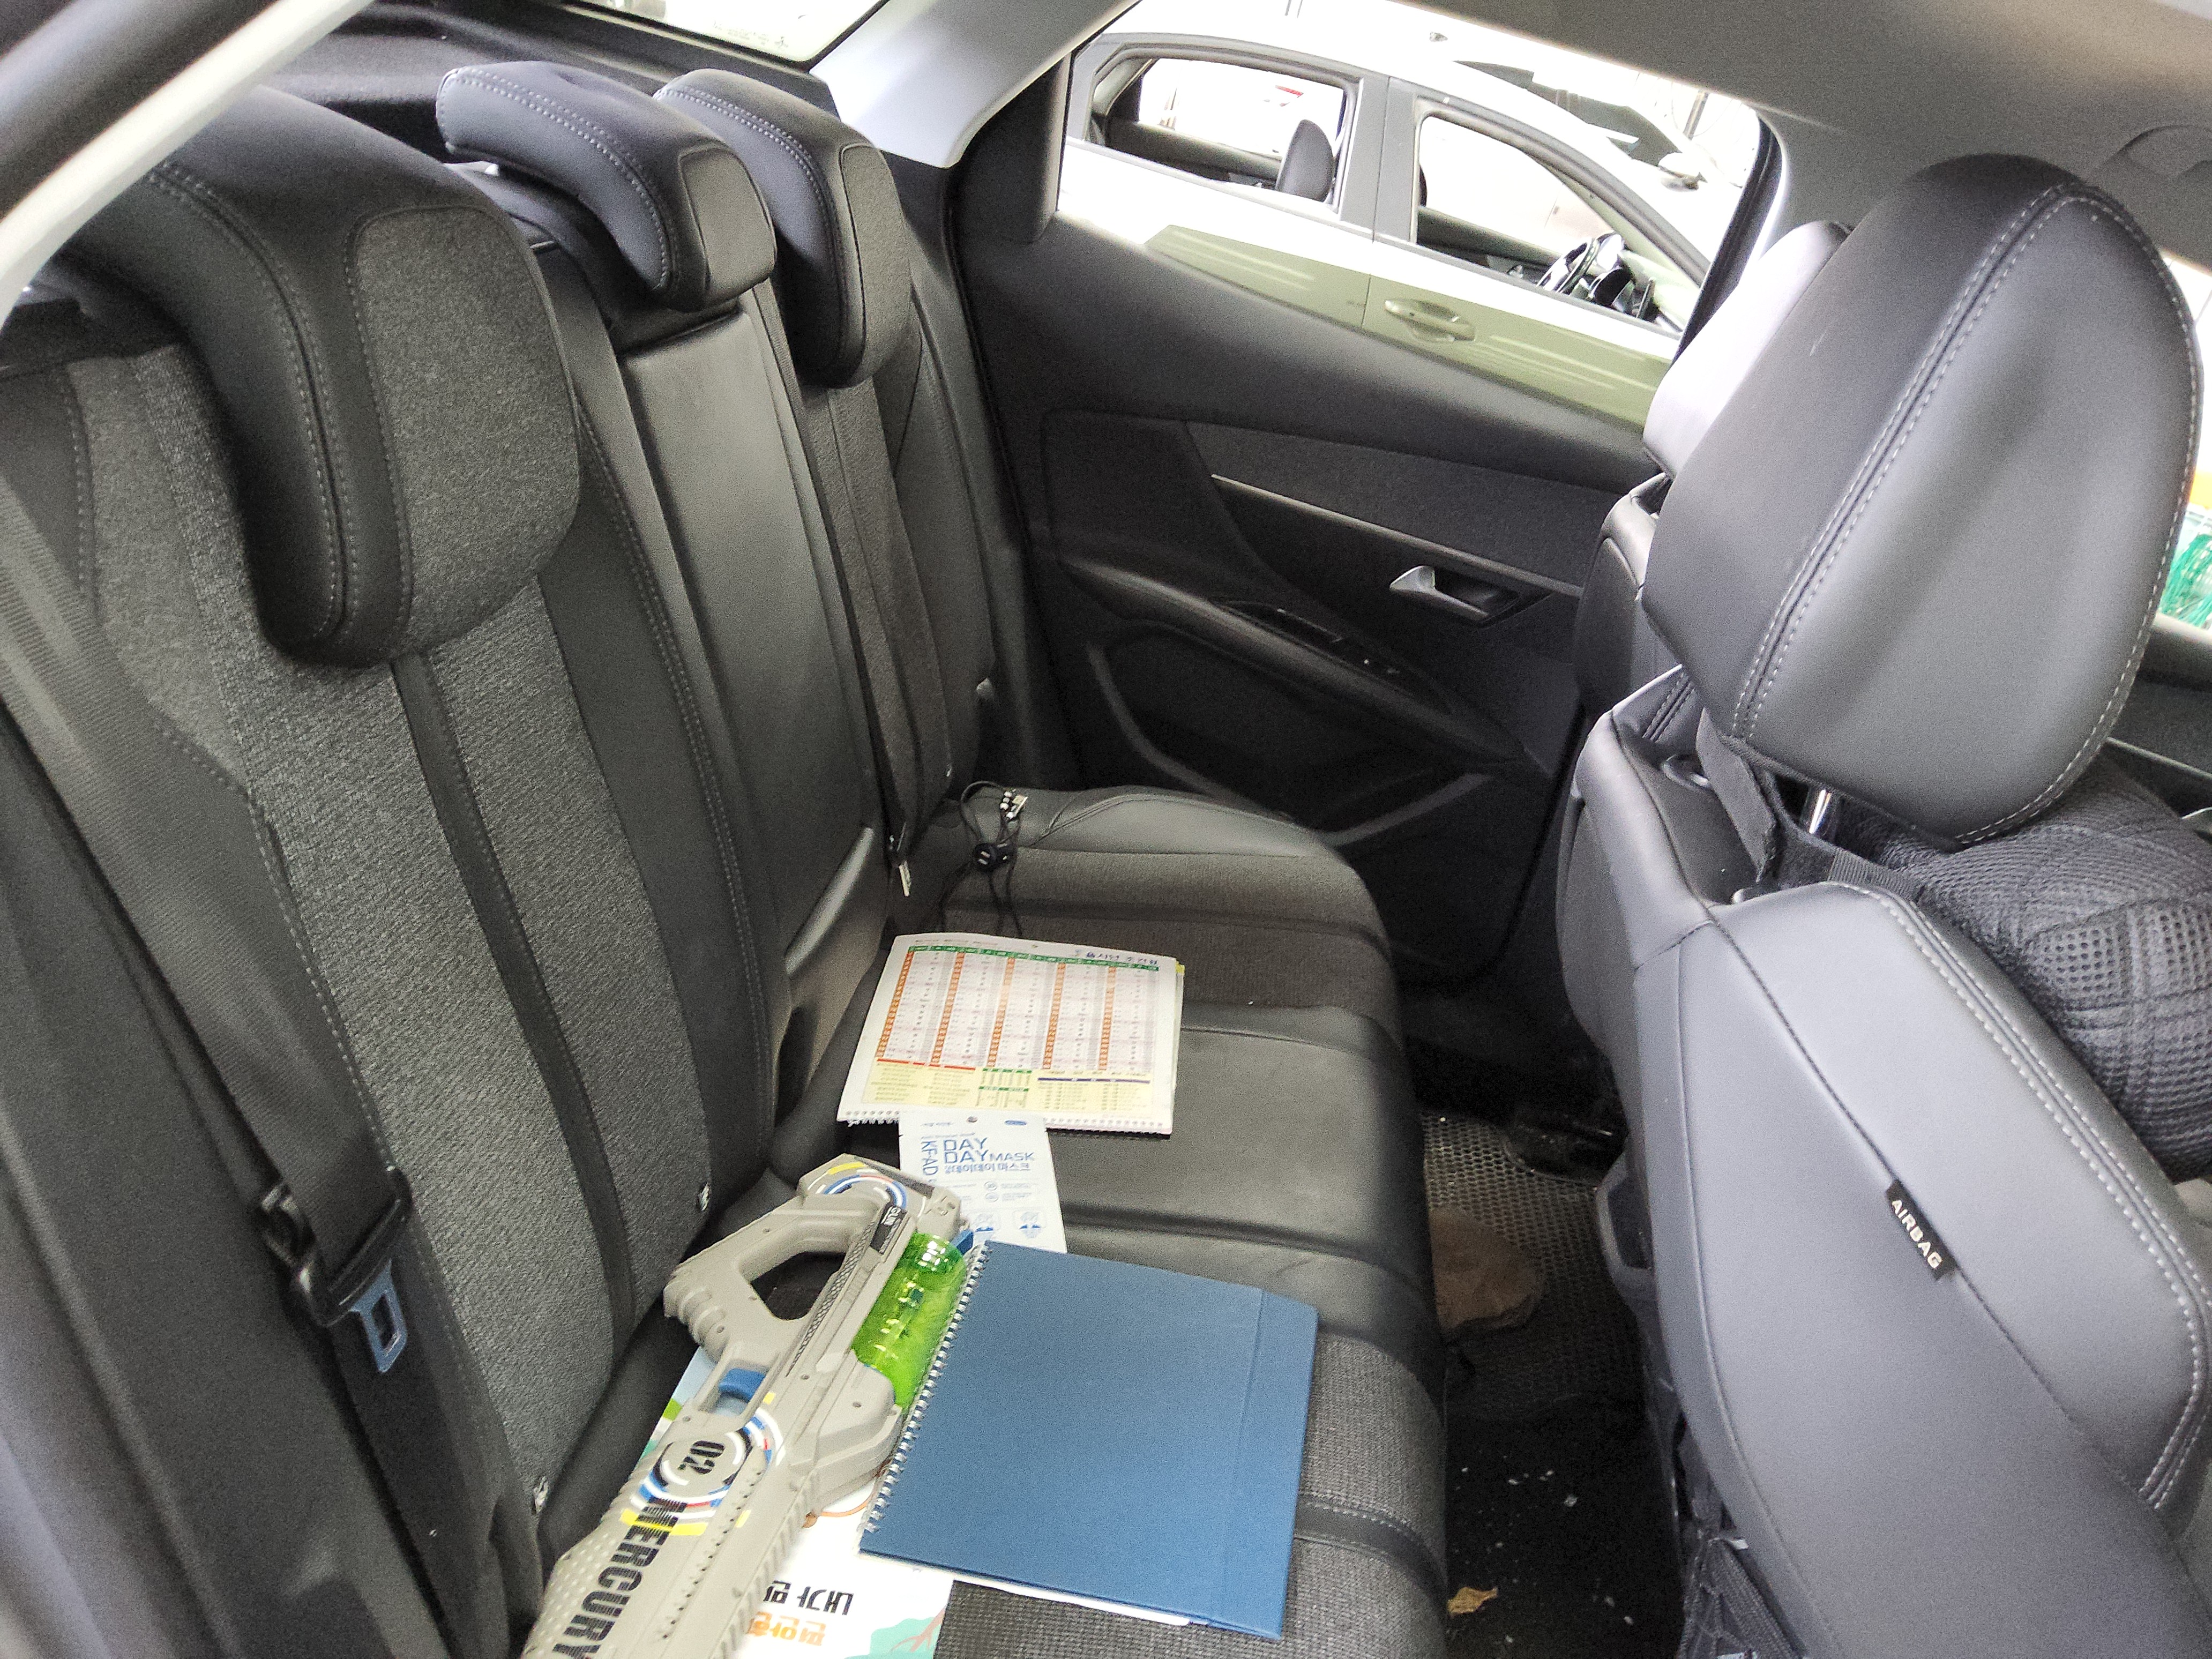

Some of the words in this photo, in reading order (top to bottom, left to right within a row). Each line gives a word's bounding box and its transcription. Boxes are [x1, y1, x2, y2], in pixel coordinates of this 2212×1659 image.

[944, 1137, 988, 1150] DAY
[945, 1150, 989, 1163] DAY
[991, 1153, 1034, 1162] MASK
[998, 1163, 1030, 1171] 마스크
[1892, 1200, 1942, 1268] AIRBAG
[677, 1440, 725, 1475] 02
[552, 1496, 687, 1659] MERCURY
[796, 1586, 855, 1616] 내가
